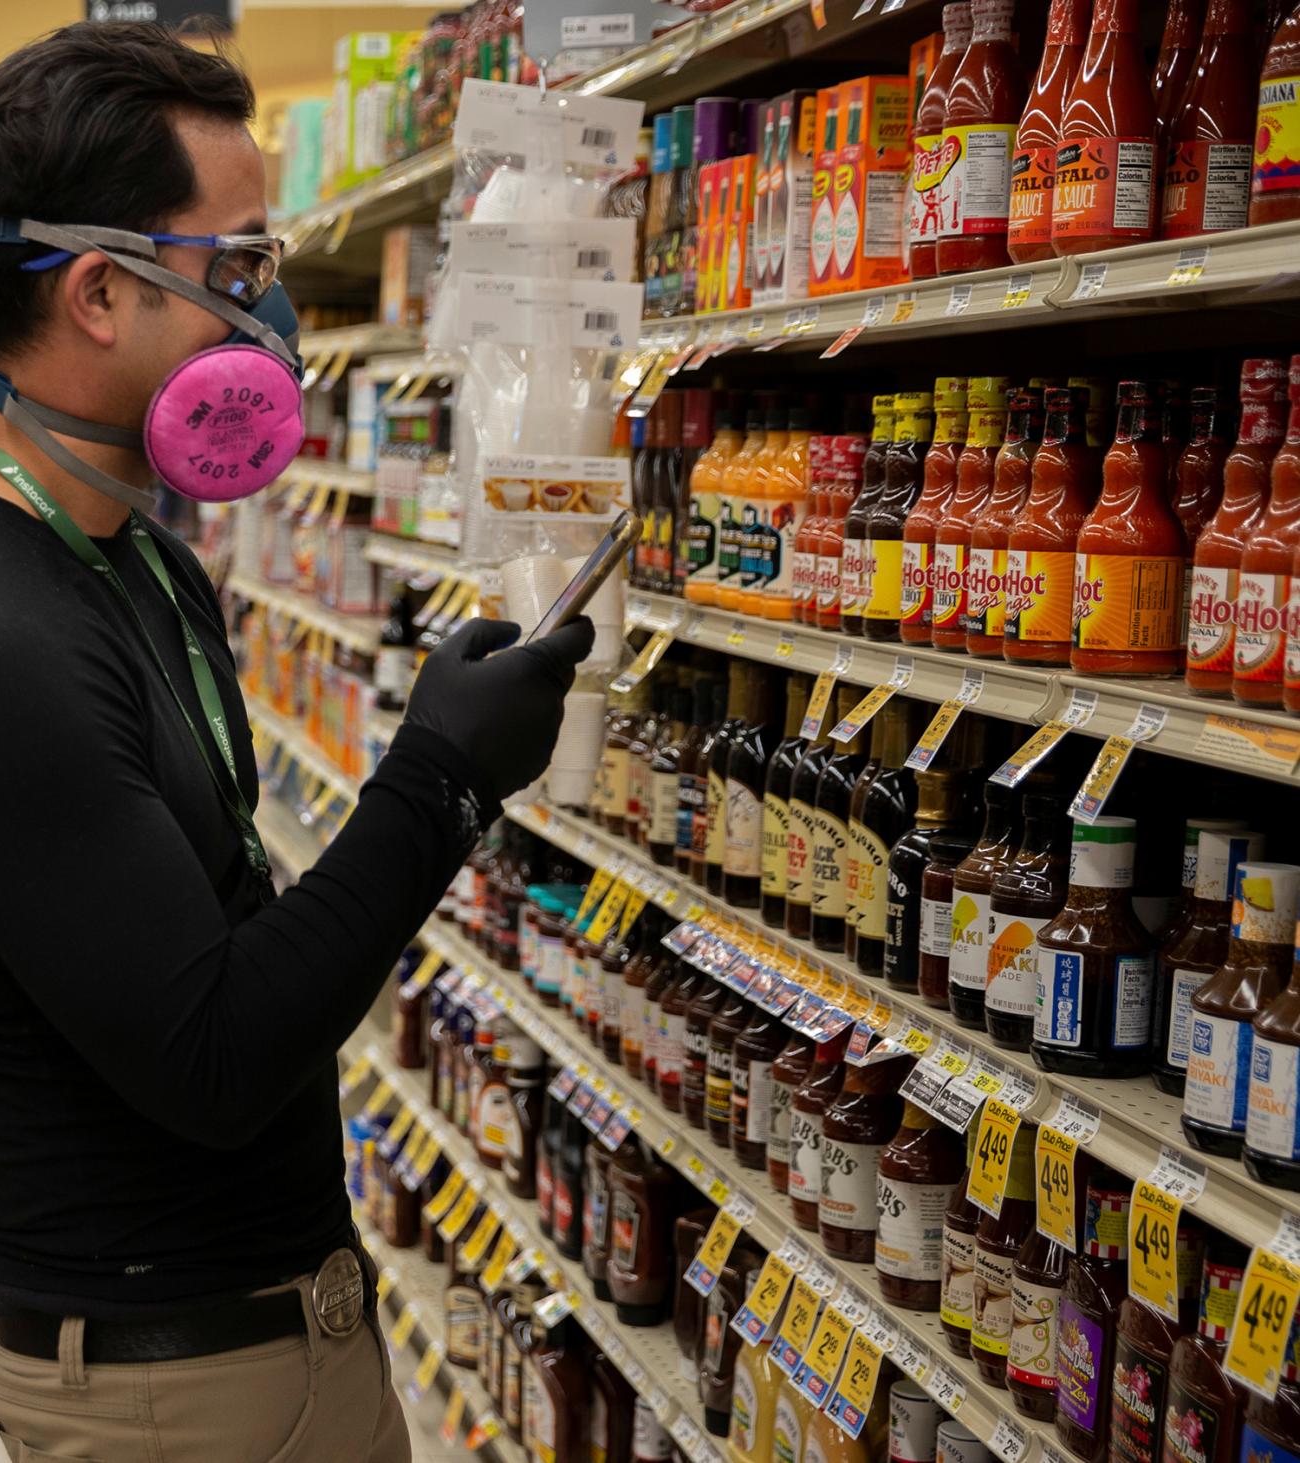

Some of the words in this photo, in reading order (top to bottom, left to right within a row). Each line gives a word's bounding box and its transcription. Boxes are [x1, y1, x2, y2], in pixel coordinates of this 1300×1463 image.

[1208, 174, 1237, 182] Calories
[186, 400, 214, 430] 3M
[223, 387, 275, 415] 2097
[213, 410, 249, 427] P100
[188, 454, 240, 479] 2097
[246, 440, 275, 469] 3M
[15, 472, 56, 519] instacart
[213, 716, 235, 766] instacart
[988, 1102, 1002, 1117] Club
[1001, 1109, 1018, 1125] Price!
[978, 1125, 1008, 1171] 449
[1042, 1130, 1055, 1144] Club
[1055, 1136, 1074, 1153] Price!
[1040, 1155, 1069, 1202] 449
[1139, 1186, 1154, 1202] Club
[1135, 1213, 1171, 1265] 449
[1244, 1283, 1288, 1339] 449
